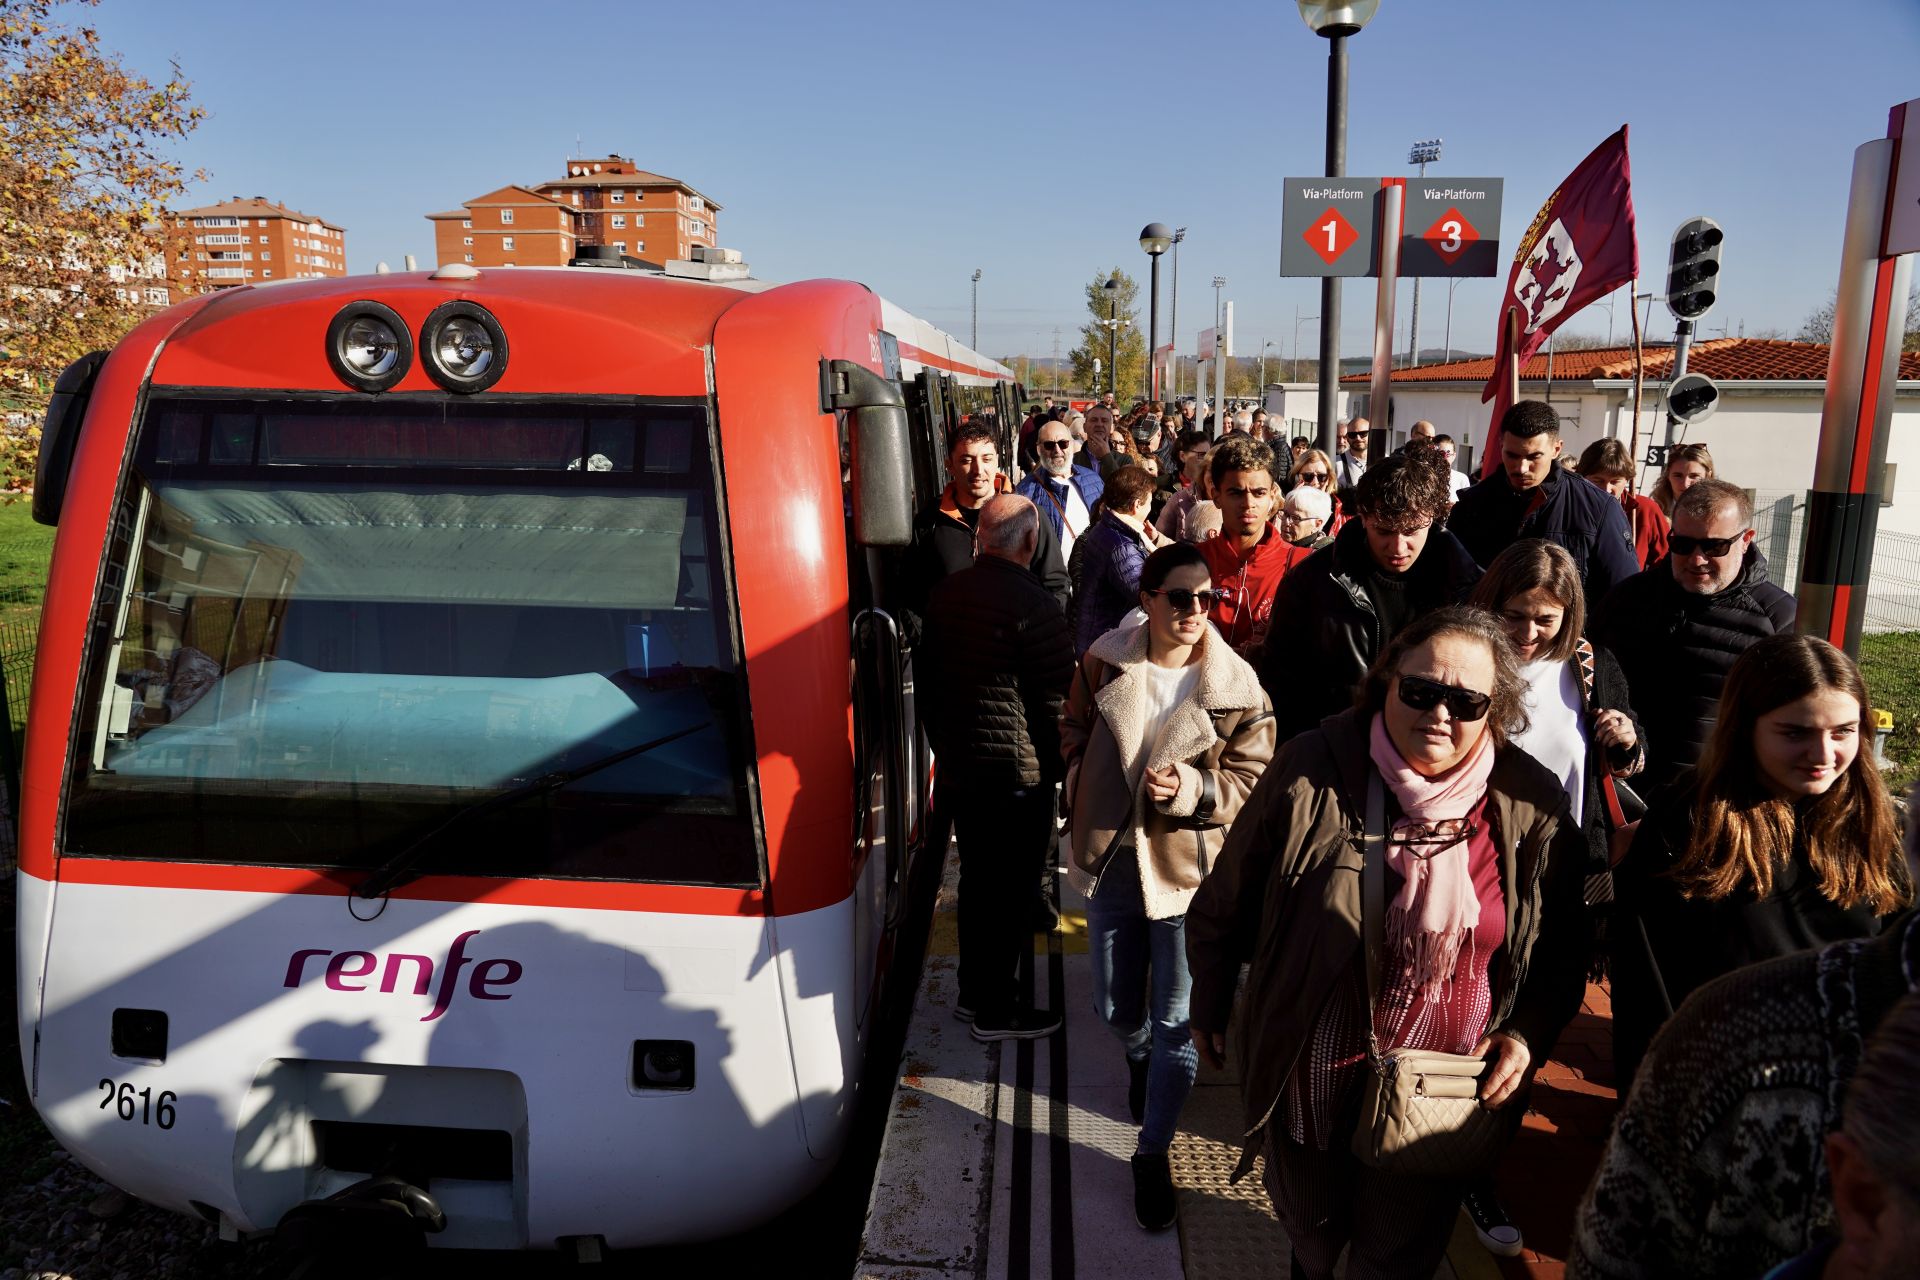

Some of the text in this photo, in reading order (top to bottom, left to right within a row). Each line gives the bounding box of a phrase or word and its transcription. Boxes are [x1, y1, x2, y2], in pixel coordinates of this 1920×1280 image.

[1322, 220, 1336, 252] 1
[1440, 221, 1462, 252] 3
[283, 930, 523, 1022] renfe
[99, 1078, 177, 1130] 2616
